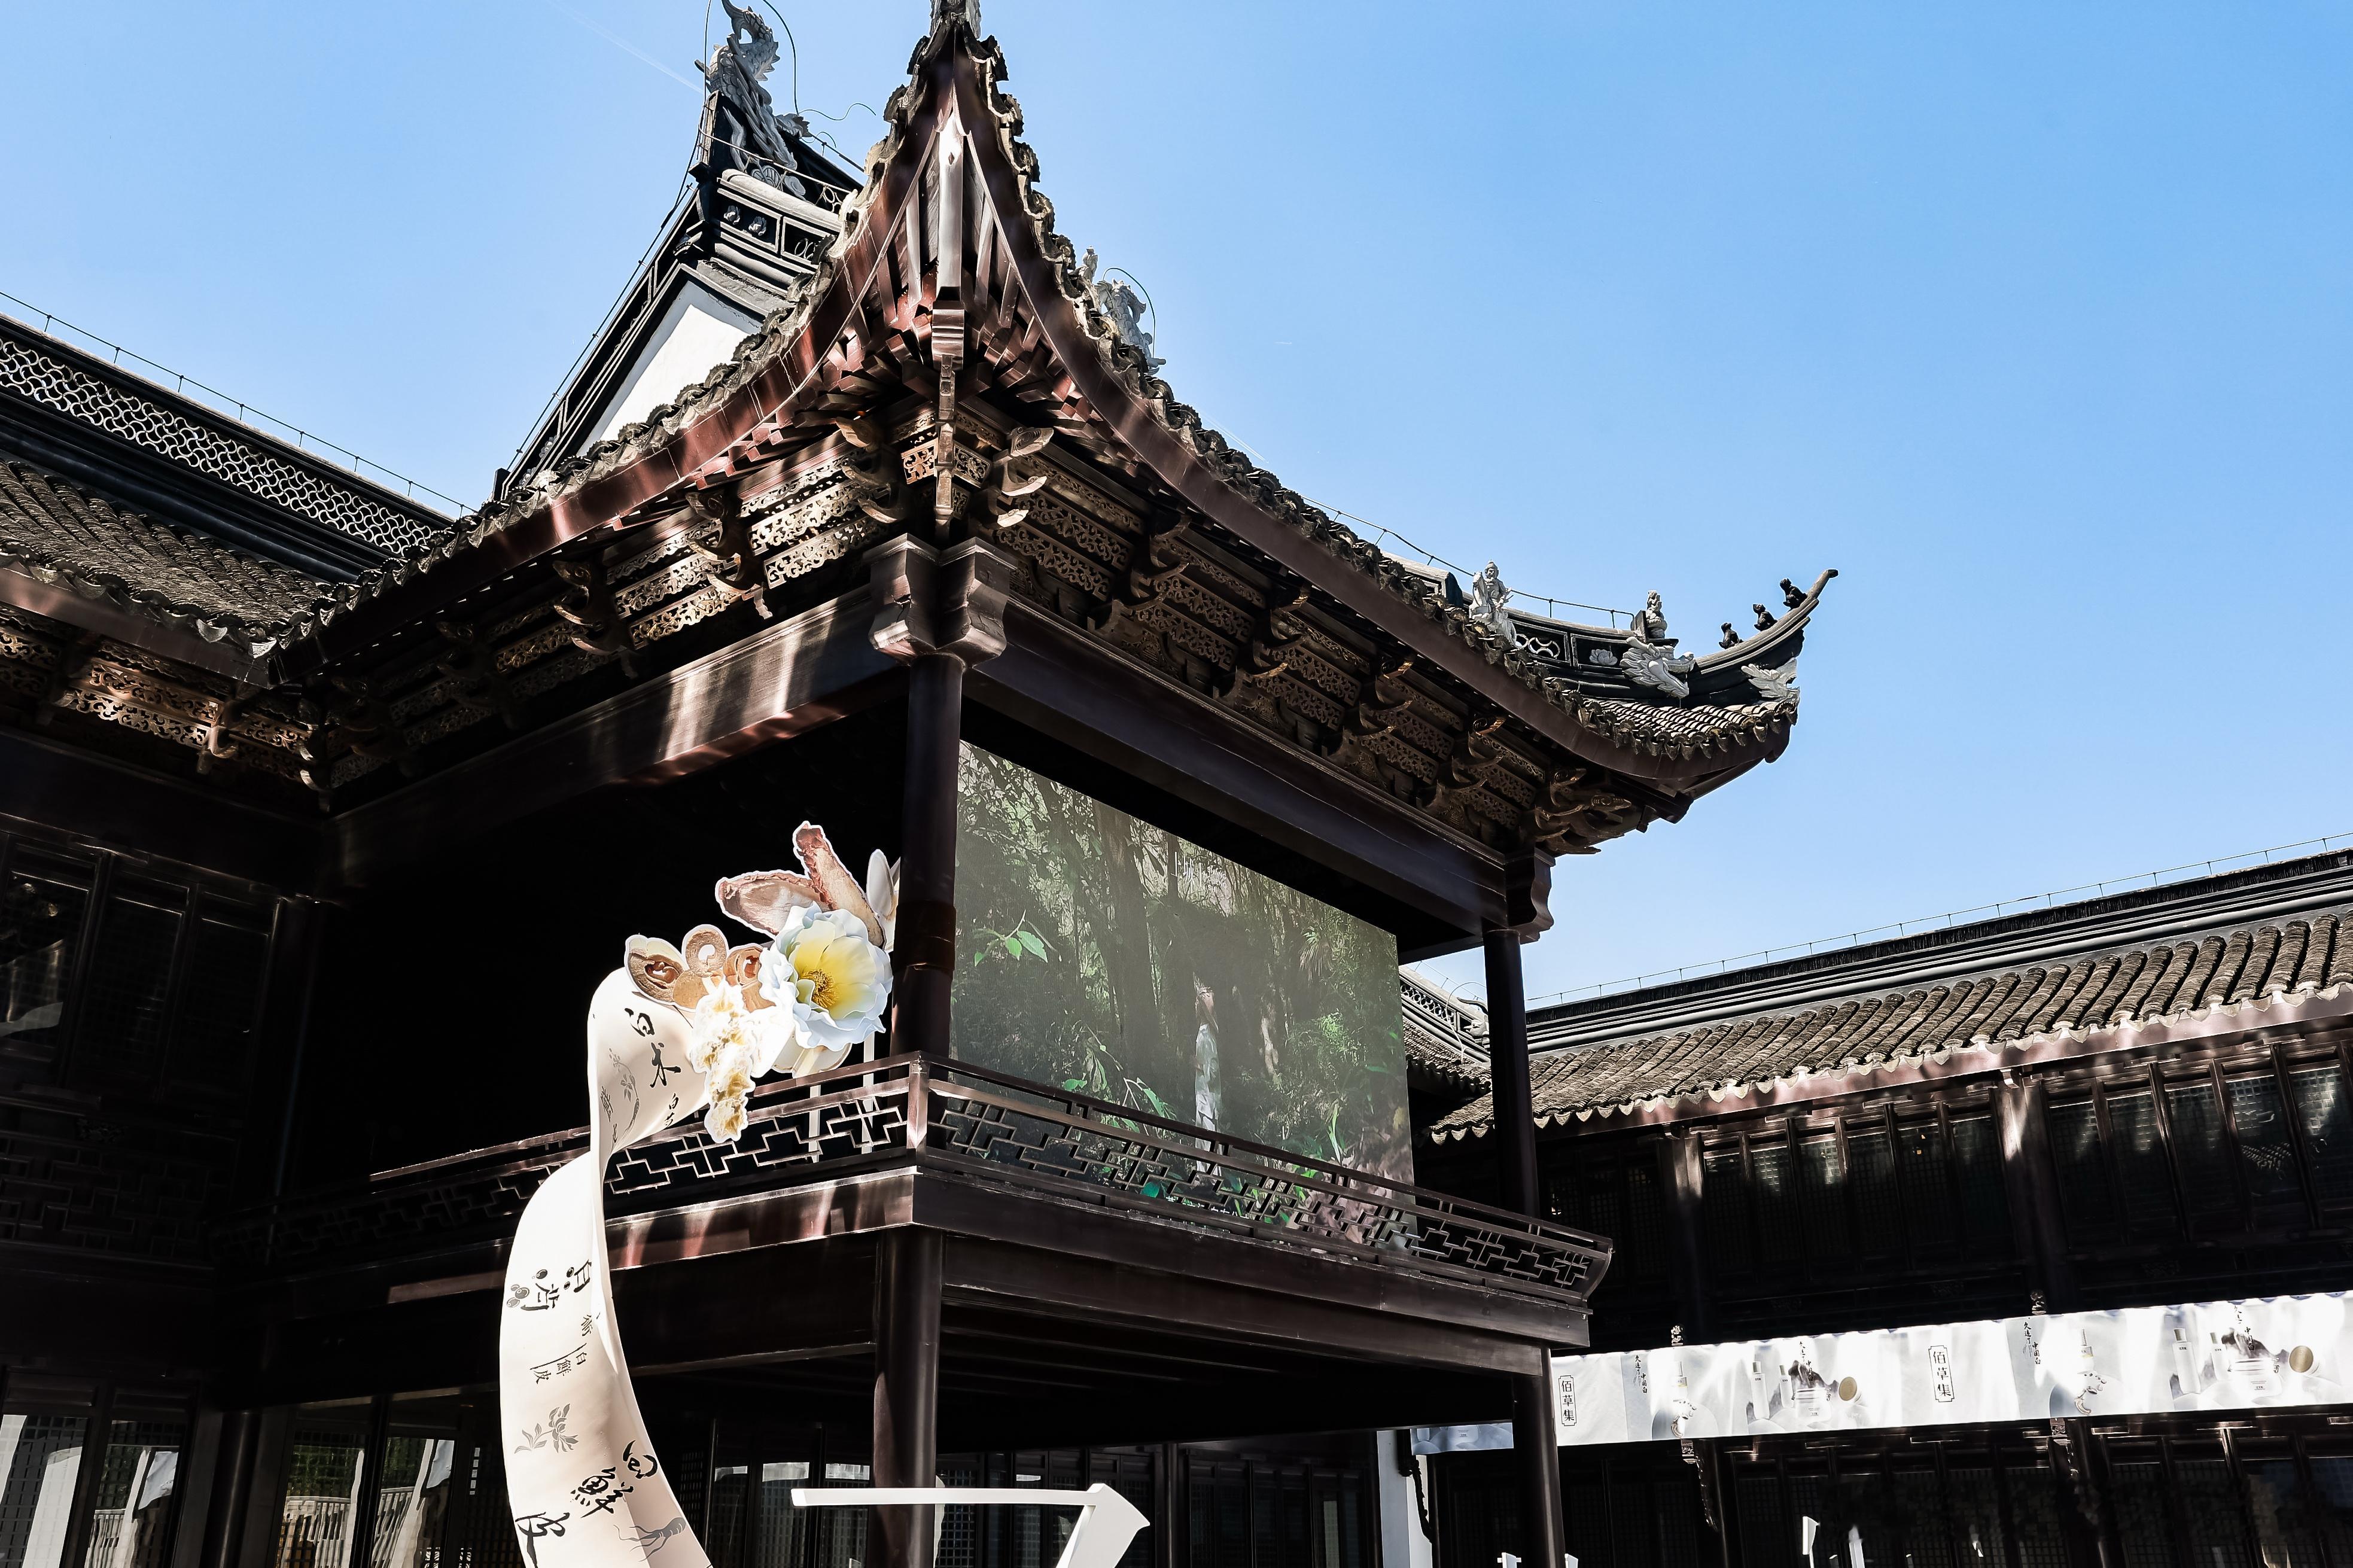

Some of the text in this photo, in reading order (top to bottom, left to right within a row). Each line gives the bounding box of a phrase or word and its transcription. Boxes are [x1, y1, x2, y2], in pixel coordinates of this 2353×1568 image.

[1207, 864, 1226, 880] SHANG
[1207, 876, 1226, 888] CHENG
[1933, 1351, 1952, 1397] 佰草集
[1561, 1380, 1574, 1421] 佰草集
